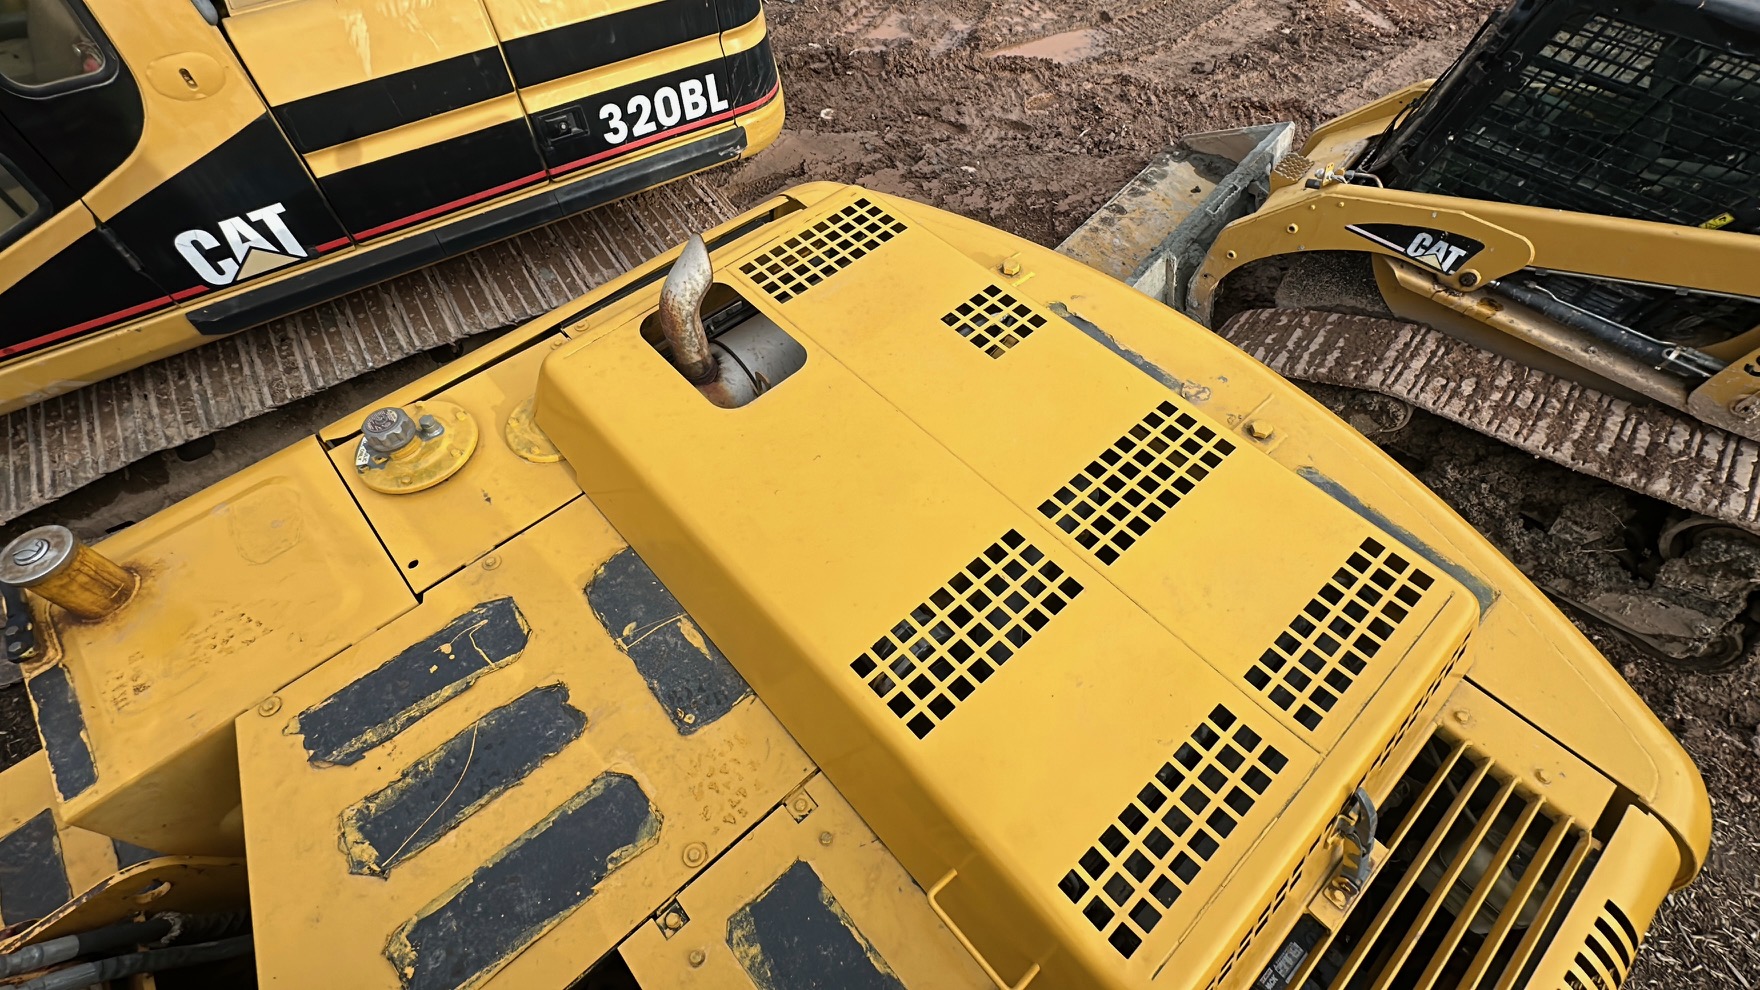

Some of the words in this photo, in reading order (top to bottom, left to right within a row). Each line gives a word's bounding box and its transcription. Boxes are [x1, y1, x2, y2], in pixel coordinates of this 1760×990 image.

[599, 73, 729, 145] 320BL
[174, 202, 308, 285] CAT
[1406, 232, 1467, 273] CAT
